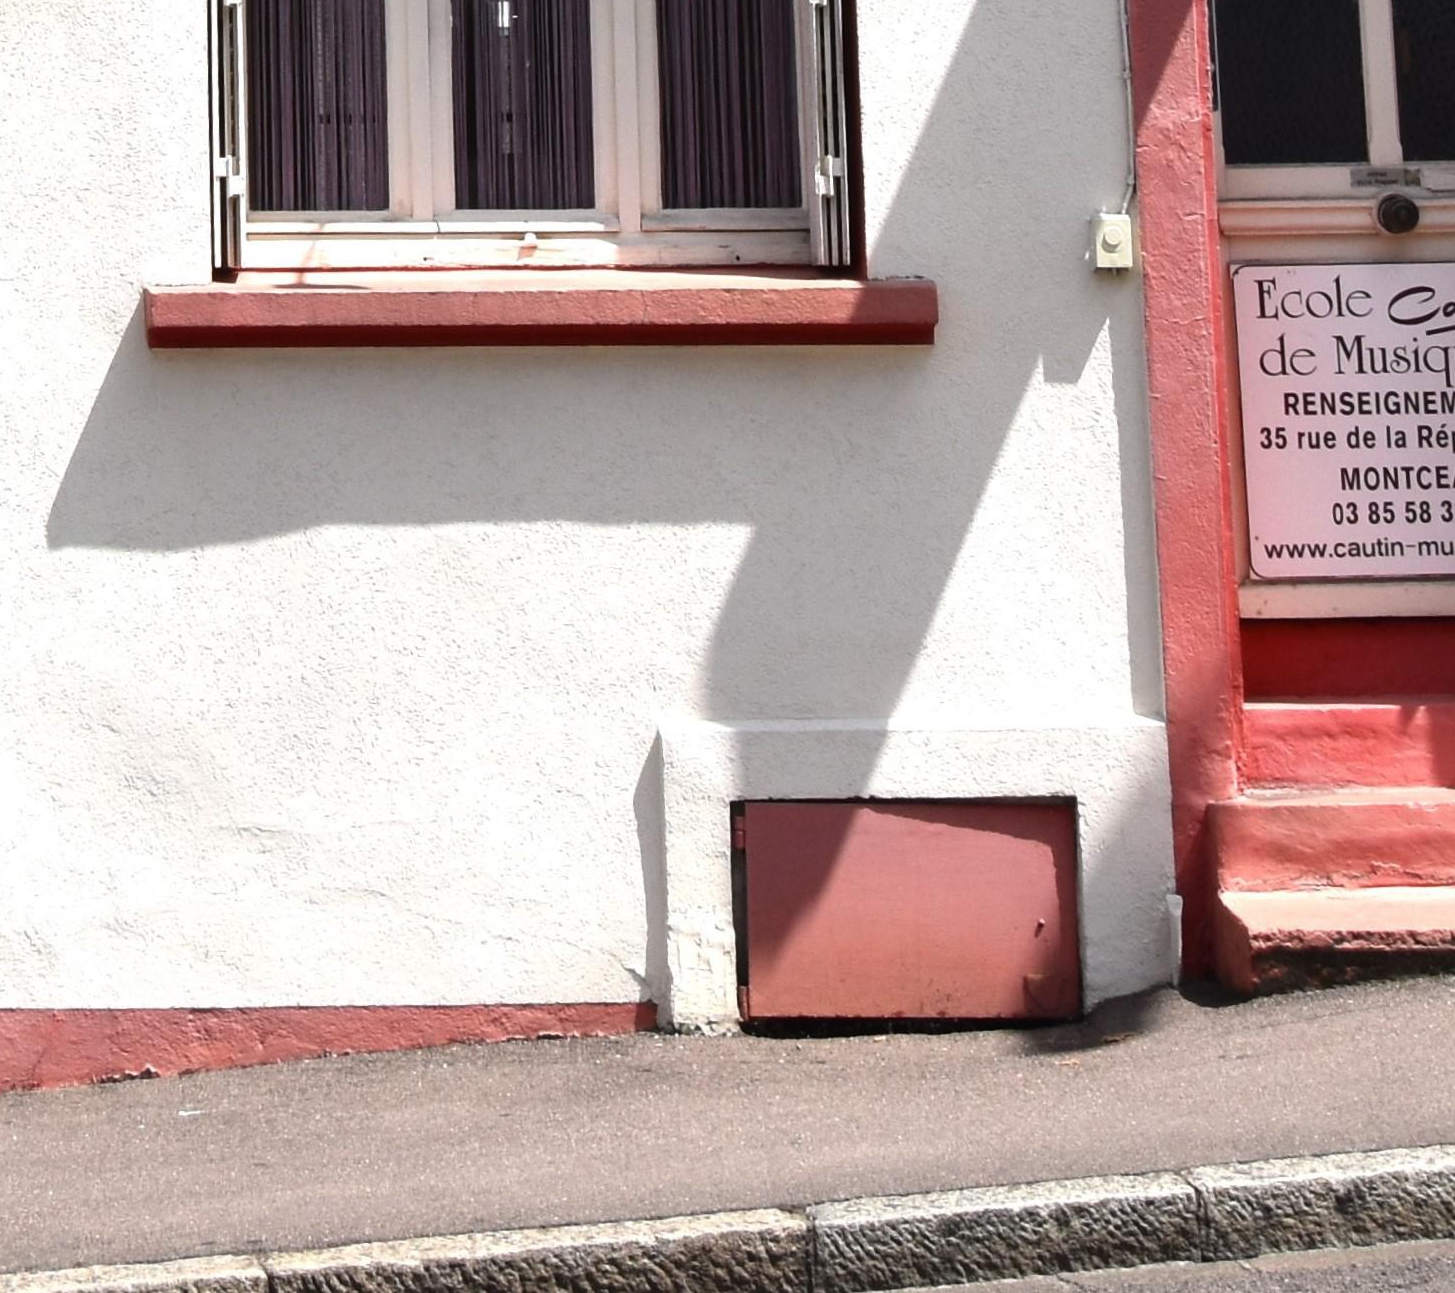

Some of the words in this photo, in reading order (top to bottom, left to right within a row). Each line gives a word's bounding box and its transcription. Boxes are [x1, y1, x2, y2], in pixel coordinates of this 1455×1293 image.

[1254, 275, 1374, 321] Ecole
[1259, 333, 1317, 376] de
[1260, 427, 1287, 449] 35
[1297, 430, 1337, 449] rue
[1346, 426, 1376, 448] de
[1386, 425, 1407, 448] la
[1332, 502, 1359, 525] 03
[1368, 501, 1395, 524] 85
[1405, 500, 1432, 523] 58
